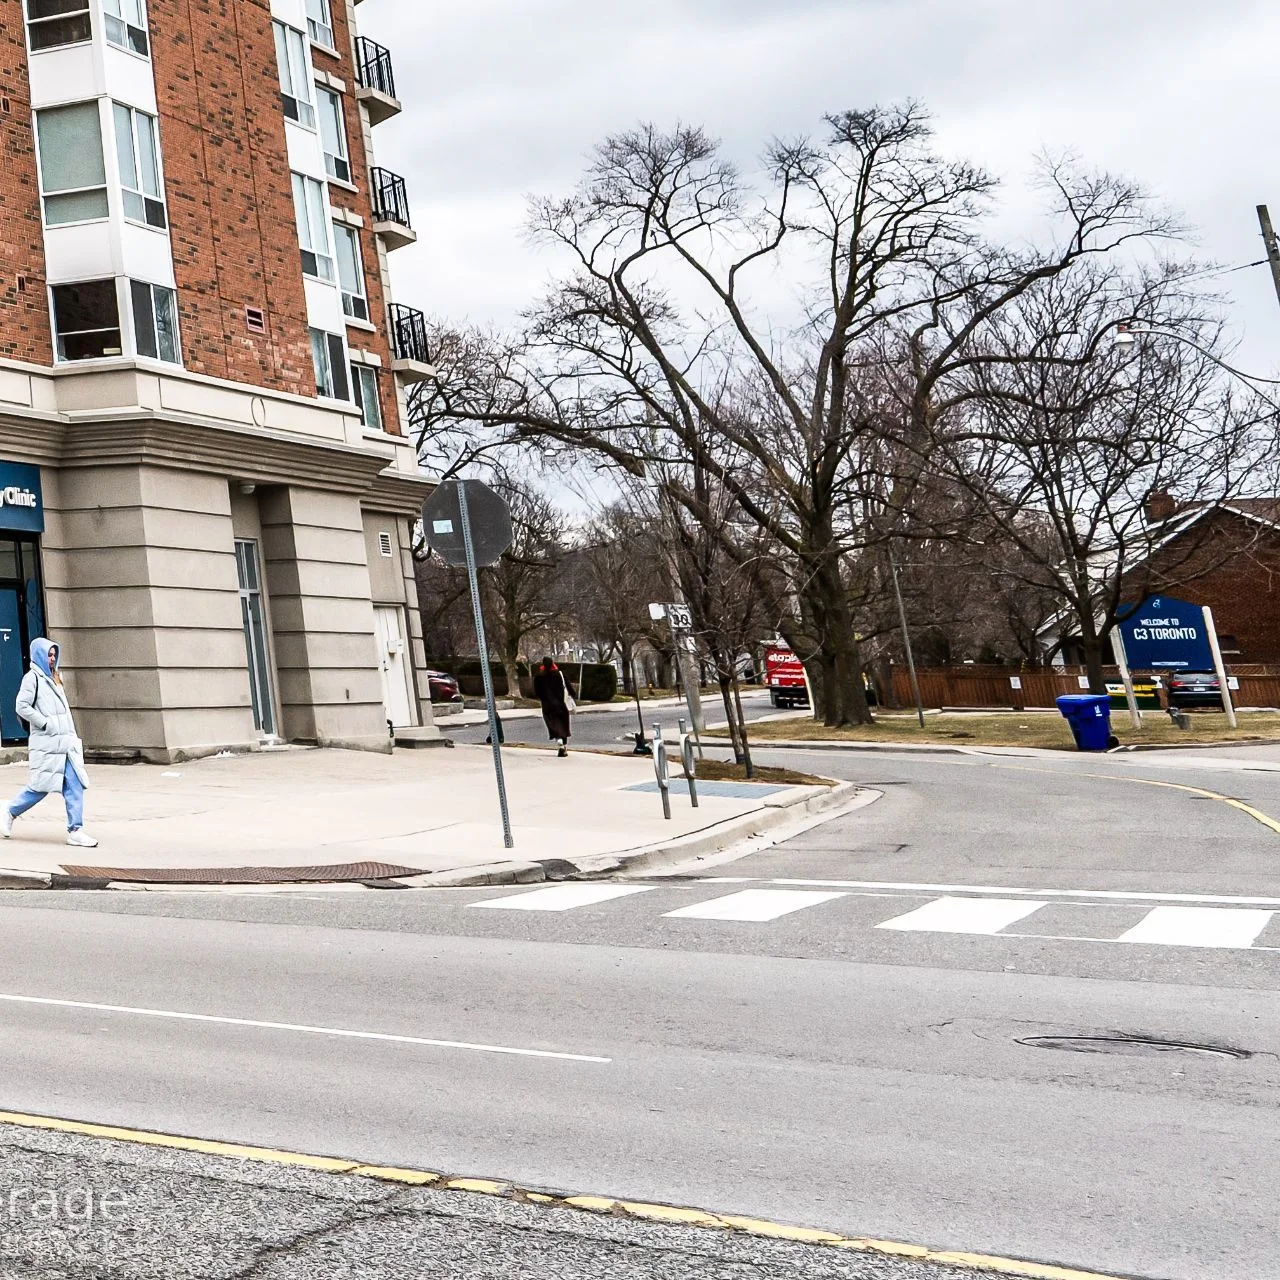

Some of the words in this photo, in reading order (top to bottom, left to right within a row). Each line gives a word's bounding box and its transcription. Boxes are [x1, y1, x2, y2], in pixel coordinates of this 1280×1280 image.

[4, 487, 37, 508] Clinic
[1140, 618, 1170, 626] WELCOME
[1170, 618, 1179, 626] TO
[1133, 628, 1148, 640] C3
[1149, 627, 1197, 640] TORONTO
